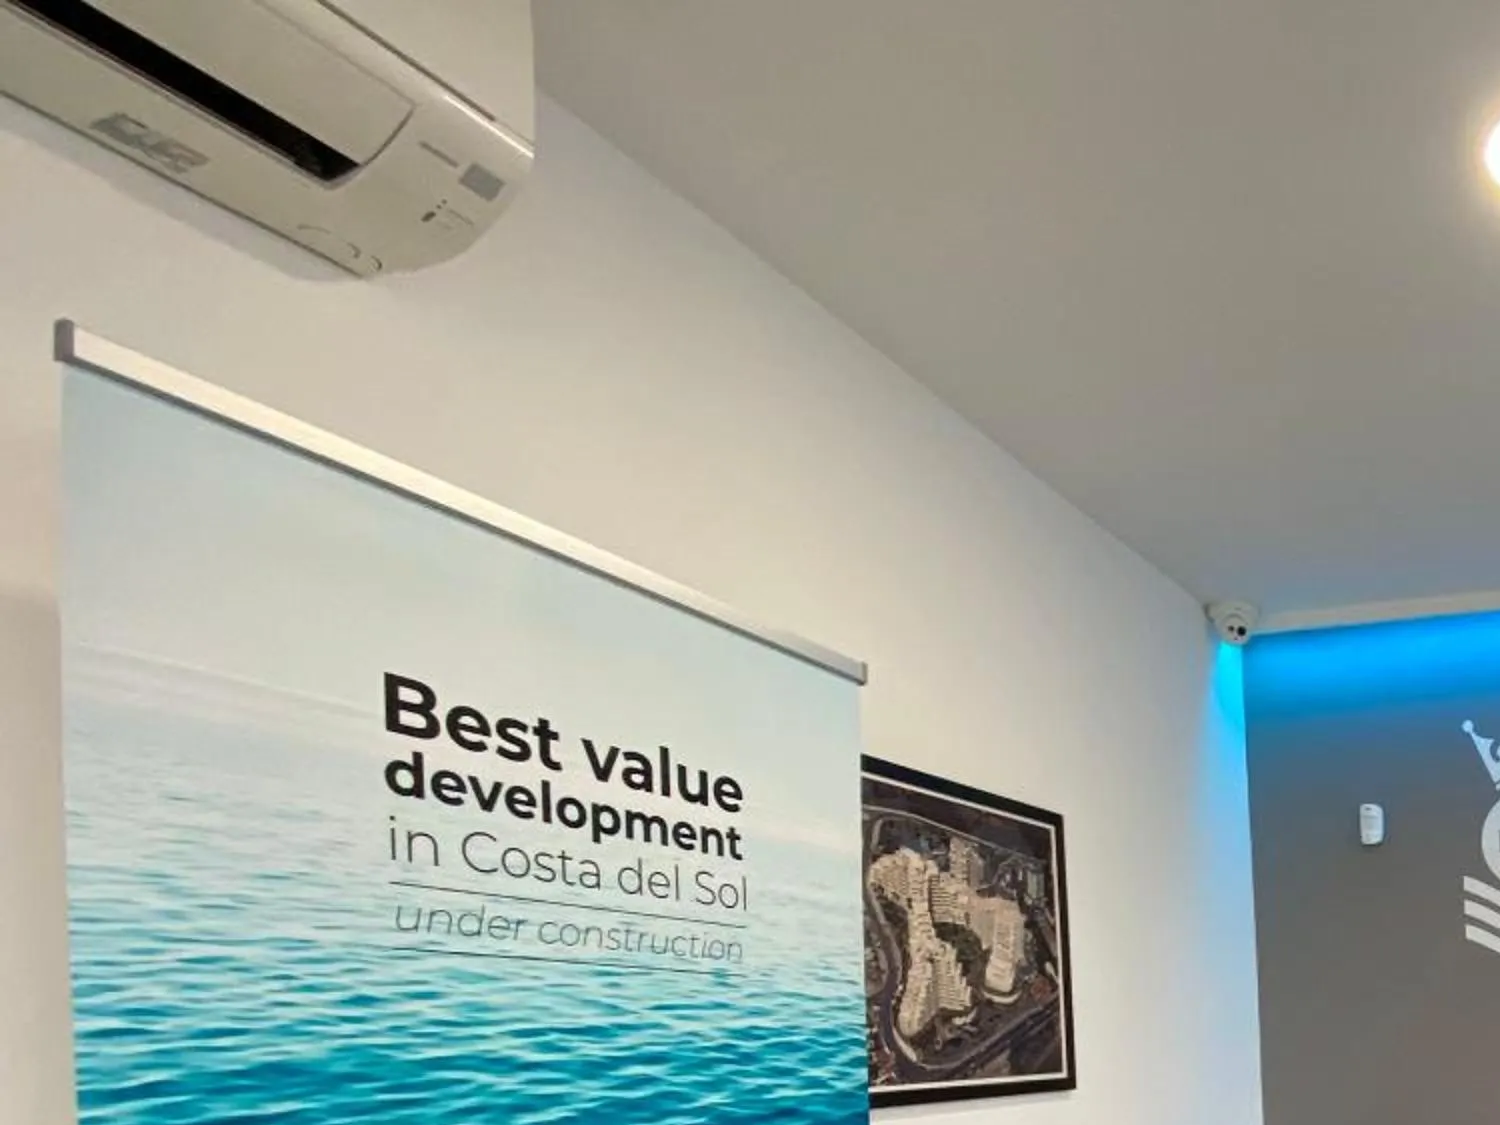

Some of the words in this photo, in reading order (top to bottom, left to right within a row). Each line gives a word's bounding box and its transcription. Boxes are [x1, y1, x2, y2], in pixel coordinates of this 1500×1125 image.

[384, 671, 563, 772] Best
[581, 737, 743, 813] value
[384, 751, 743, 860] development
[389, 815, 440, 867] in
[461, 830, 601, 890] Costa
[618, 857, 681, 901] del
[694, 870, 748, 912] Sol
[395, 904, 529, 942] under
[537, 919, 743, 963] construction
